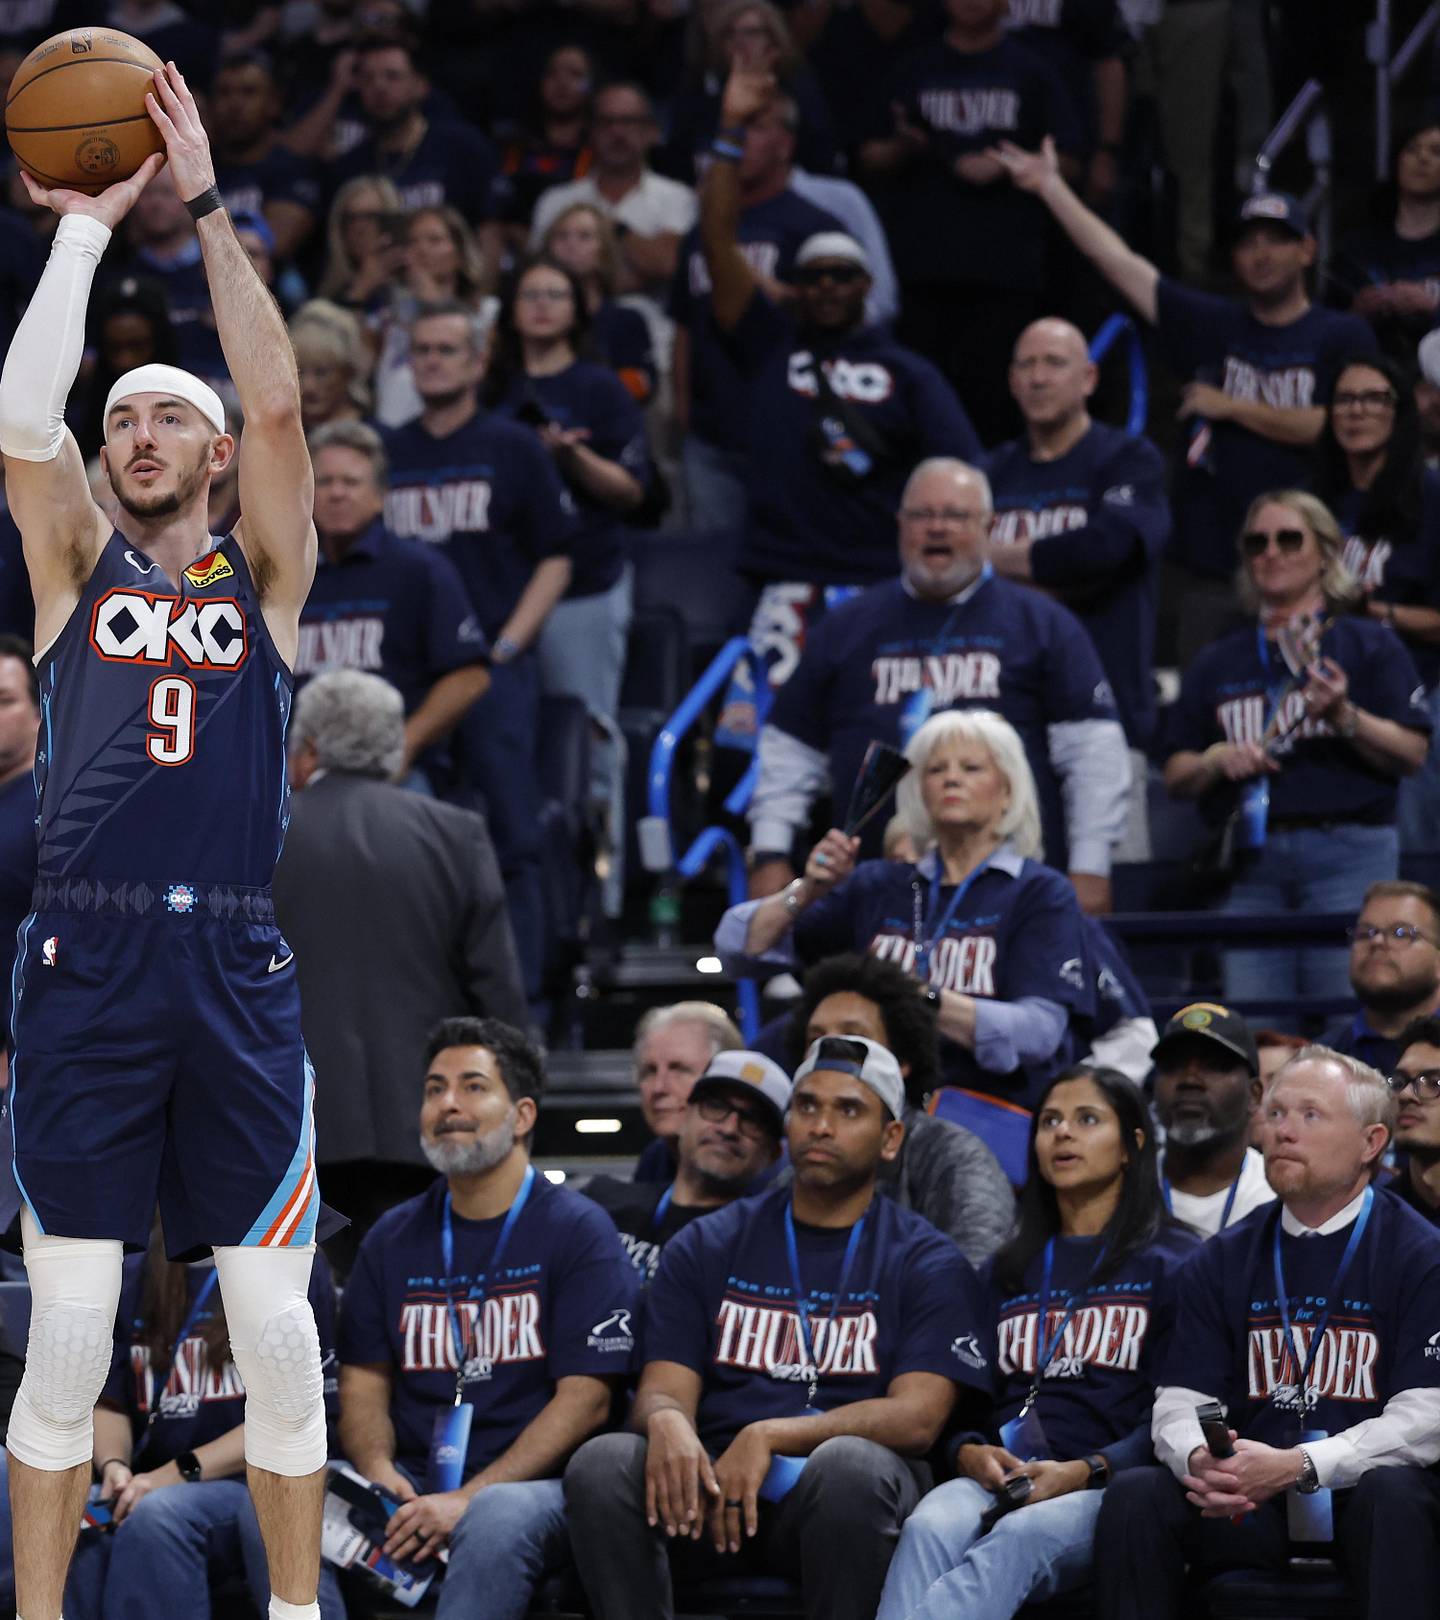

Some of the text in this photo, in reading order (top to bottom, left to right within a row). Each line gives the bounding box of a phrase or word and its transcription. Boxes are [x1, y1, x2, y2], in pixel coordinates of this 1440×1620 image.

[91, 589, 247, 669] OKC
[148, 675, 196, 765] 9
[716, 1298, 879, 1375] THUNDER
